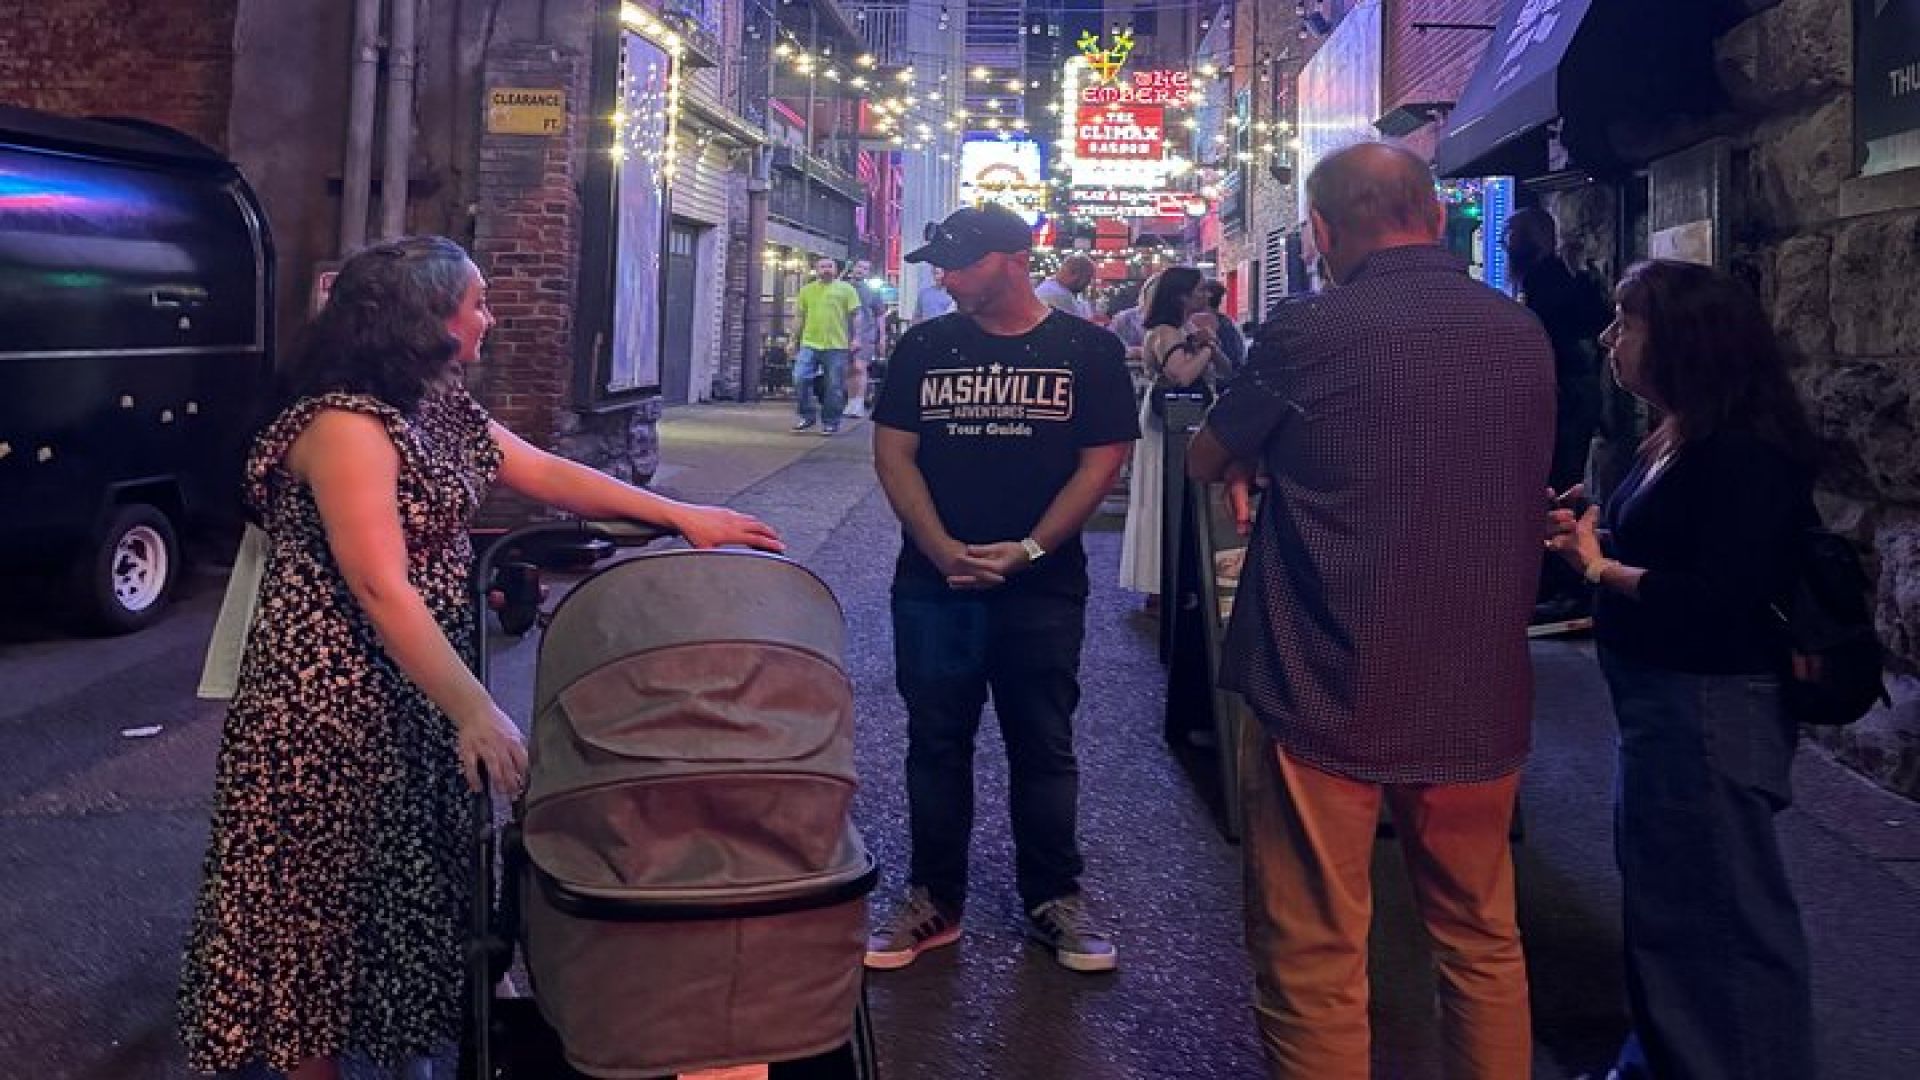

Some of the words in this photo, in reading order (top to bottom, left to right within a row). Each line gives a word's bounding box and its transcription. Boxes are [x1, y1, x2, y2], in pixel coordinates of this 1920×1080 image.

[493, 93, 561, 106] CLEARANCE
[1079, 125, 1161, 141] CLIMAX
[920, 375, 1071, 406] NASHVILLE
[946, 422, 983, 436] Tour
[986, 422, 1033, 437] Guide
